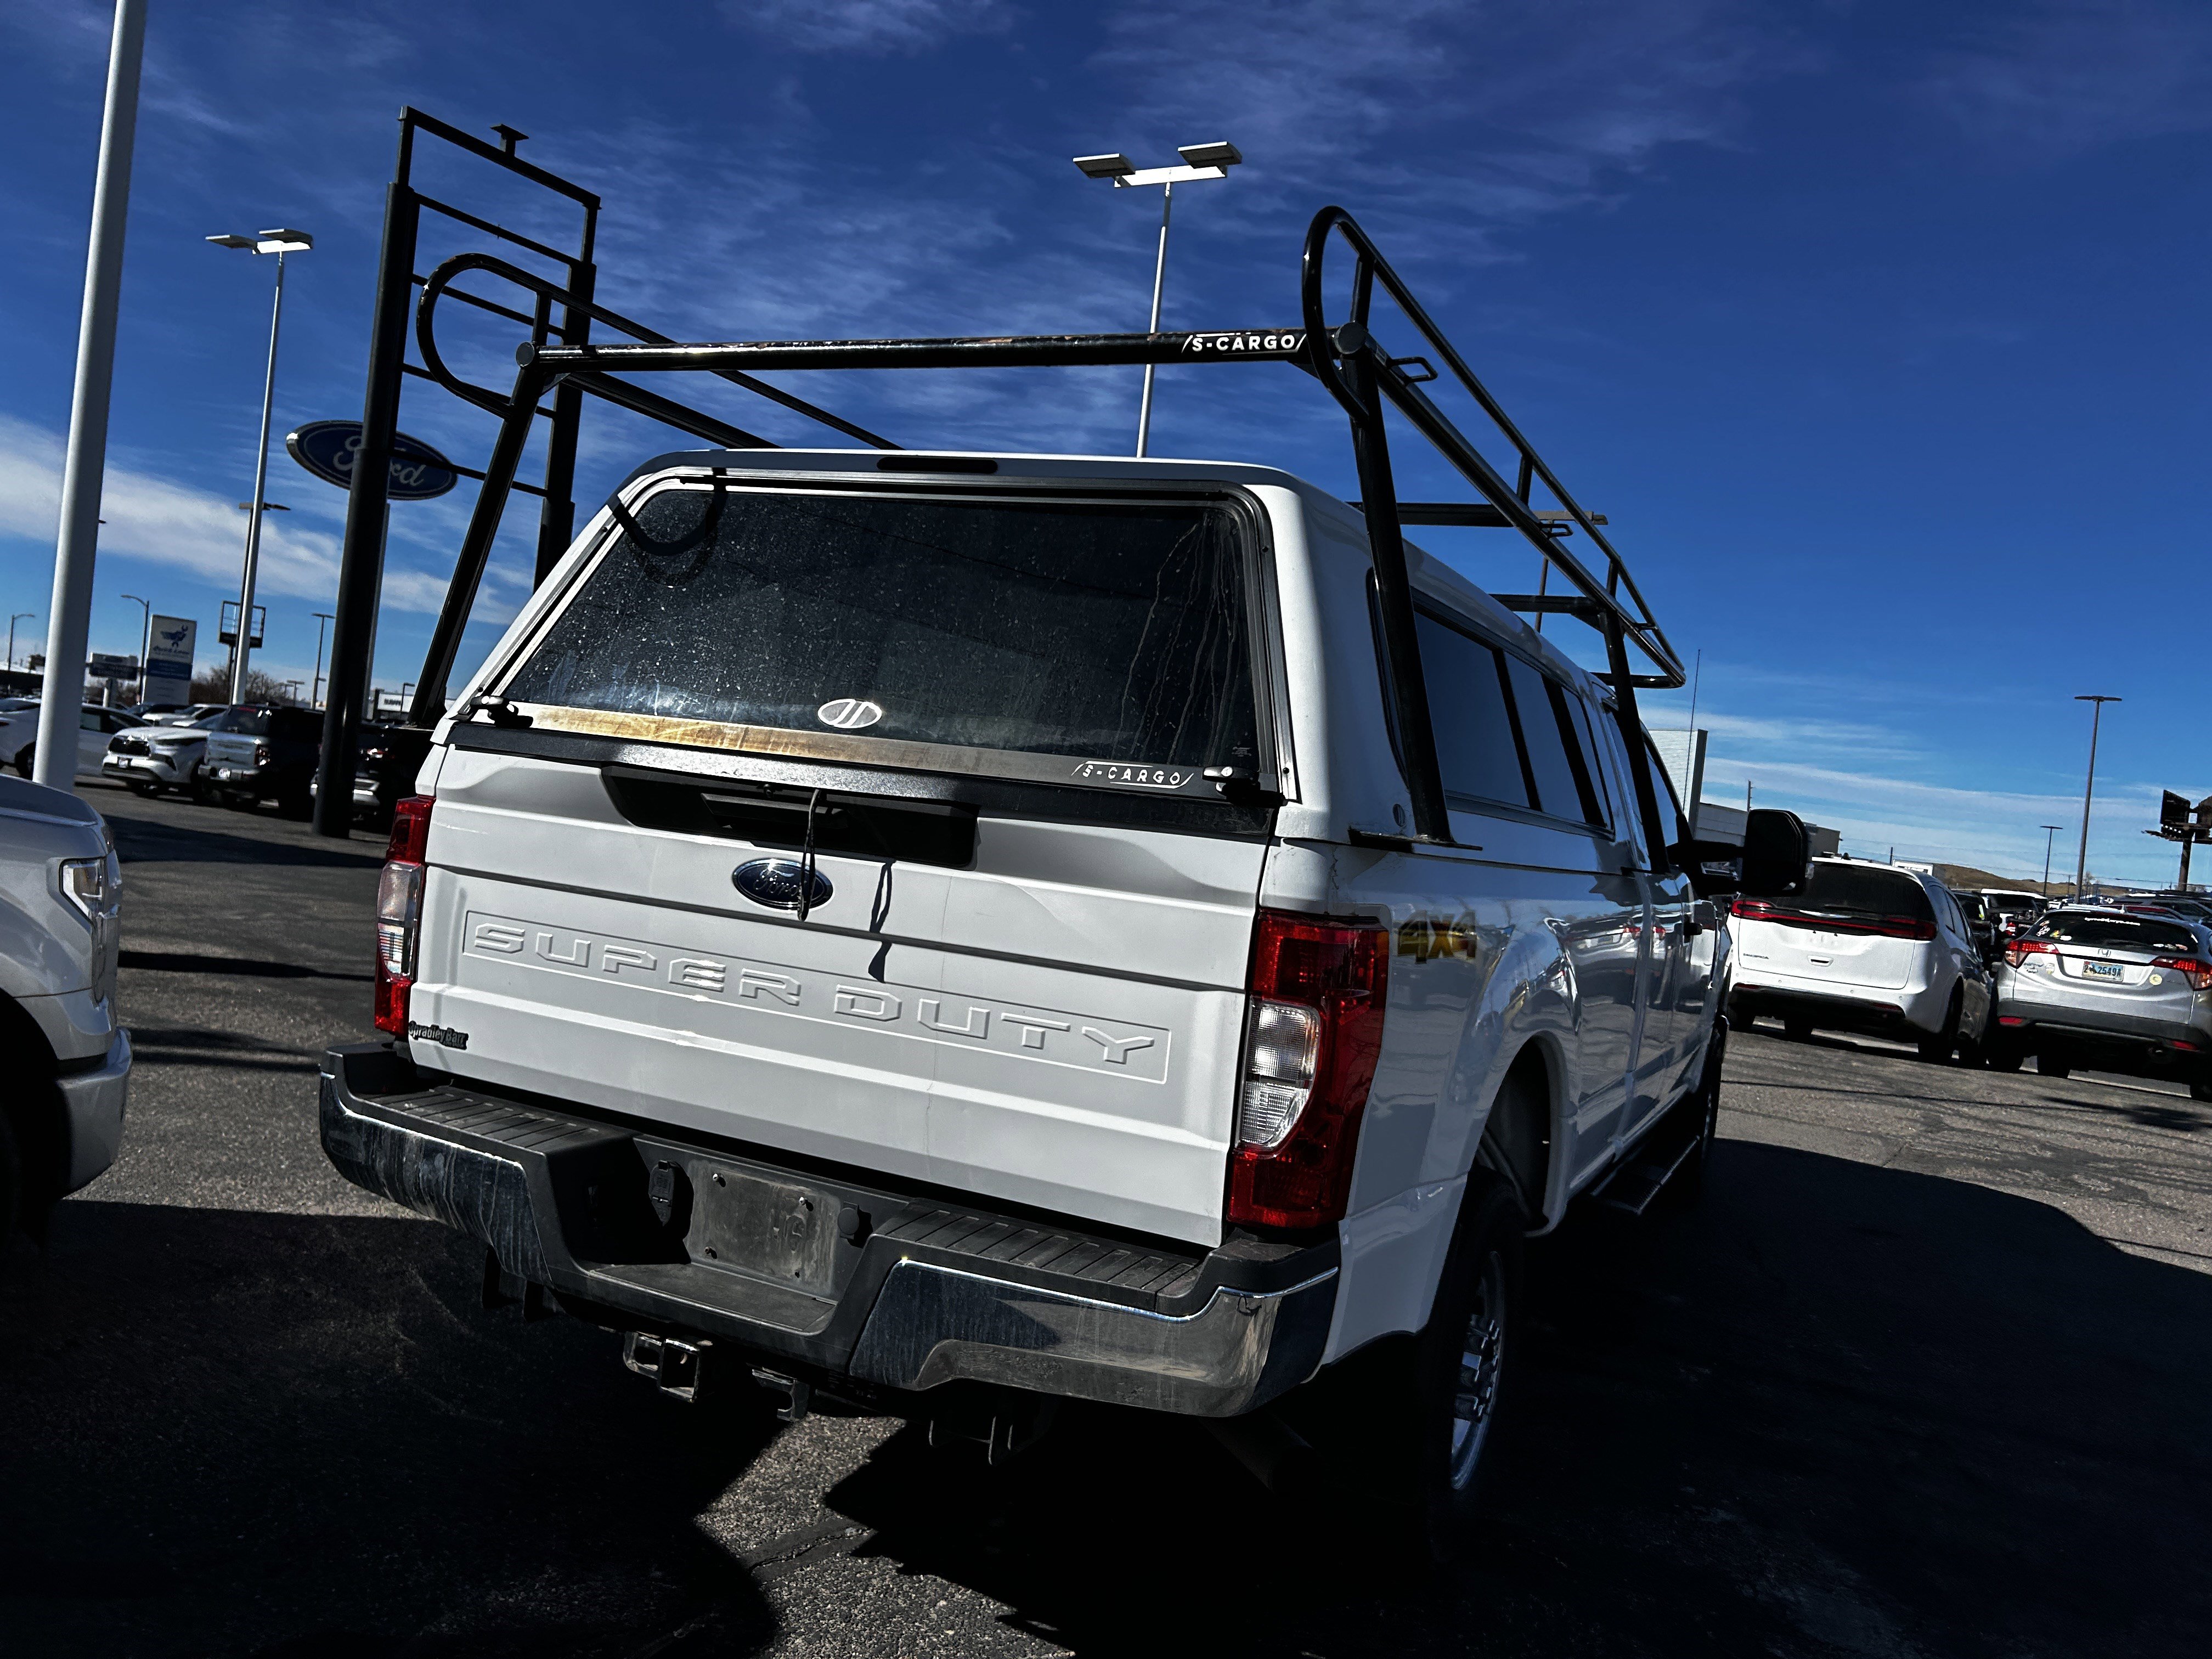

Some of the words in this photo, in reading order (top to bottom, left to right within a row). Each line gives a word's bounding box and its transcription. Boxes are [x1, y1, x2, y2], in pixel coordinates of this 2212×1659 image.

[1192, 334, 1295, 352] S-CARGO
[1082, 764, 1180, 785] S-CARGO
[475, 922, 802, 1007] SUPER
[833, 984, 1154, 1065] DUTY
